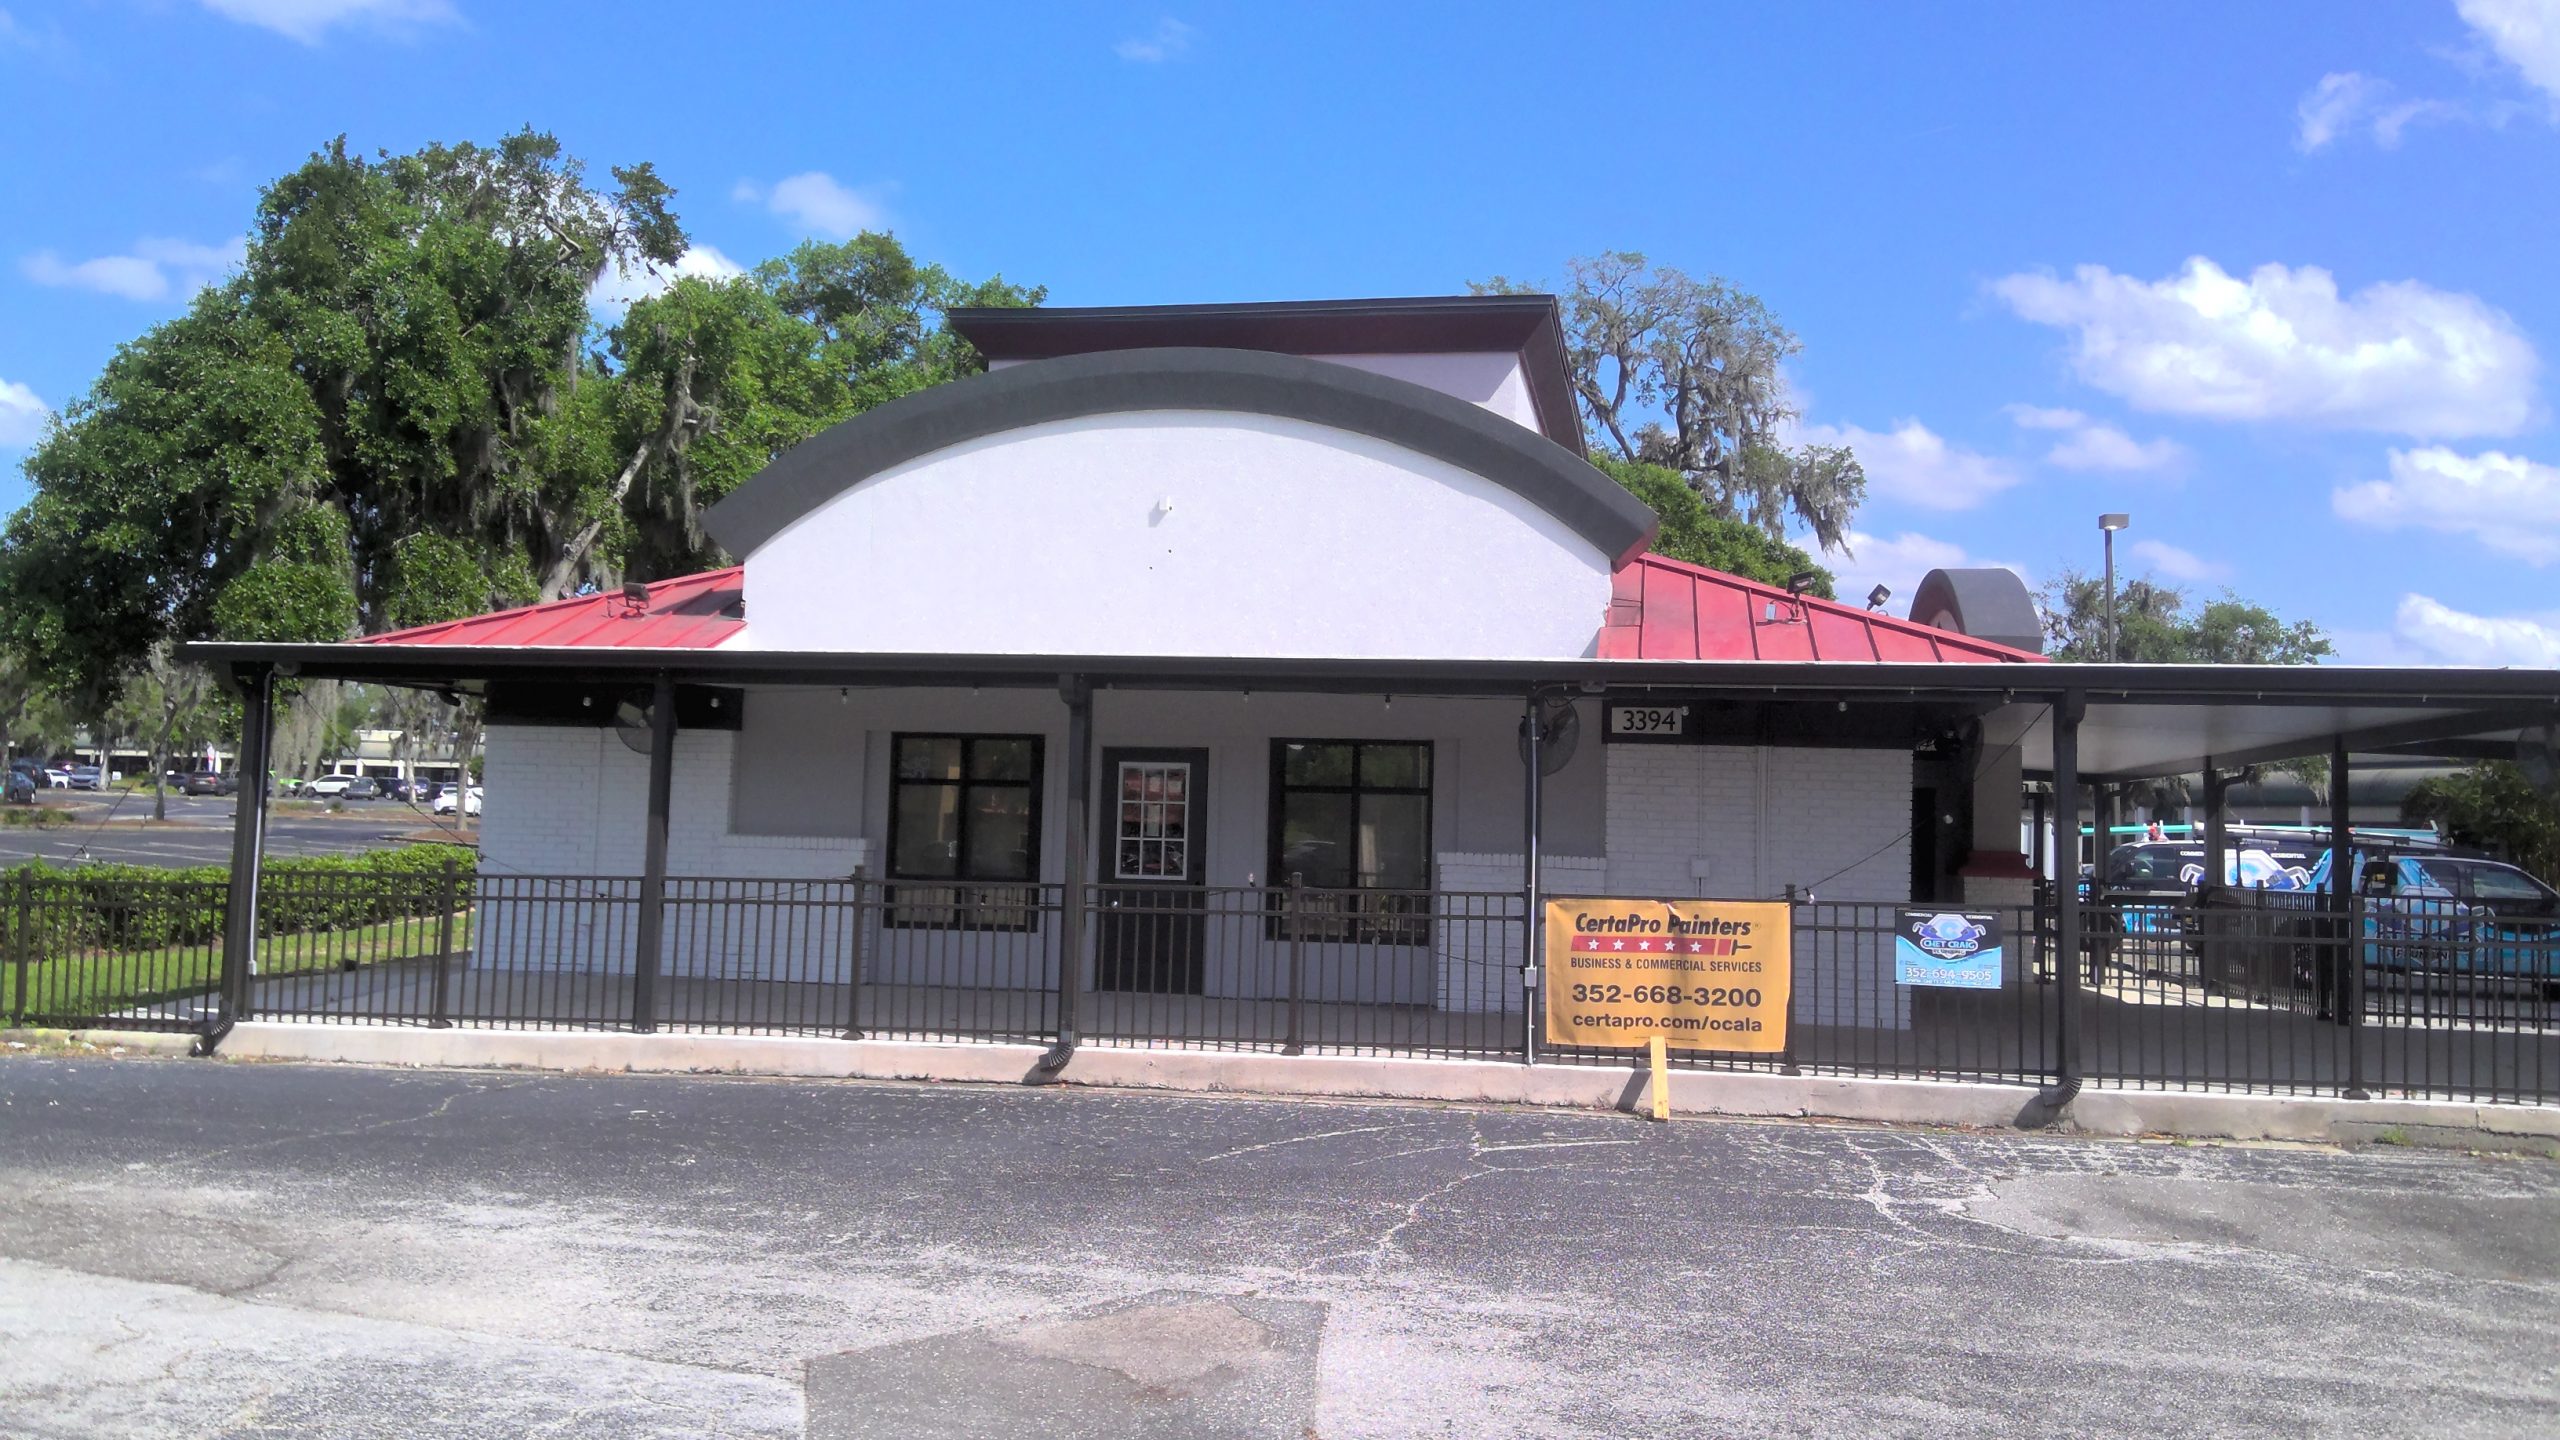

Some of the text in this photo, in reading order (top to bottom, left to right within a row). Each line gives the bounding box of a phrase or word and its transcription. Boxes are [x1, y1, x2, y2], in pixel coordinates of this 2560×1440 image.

[1623, 710, 1675, 731] 3394
[1576, 912, 1751, 936] CertaPro Painters
[1923, 940, 1975, 949] CHET CRAIG
[1571, 957, 1762, 973] BUSINESS & COMMERCIAL SERVICES
[1572, 984, 1762, 1007] 352-668-3200
[1573, 1013, 1762, 1032] certapro.com/ocala
